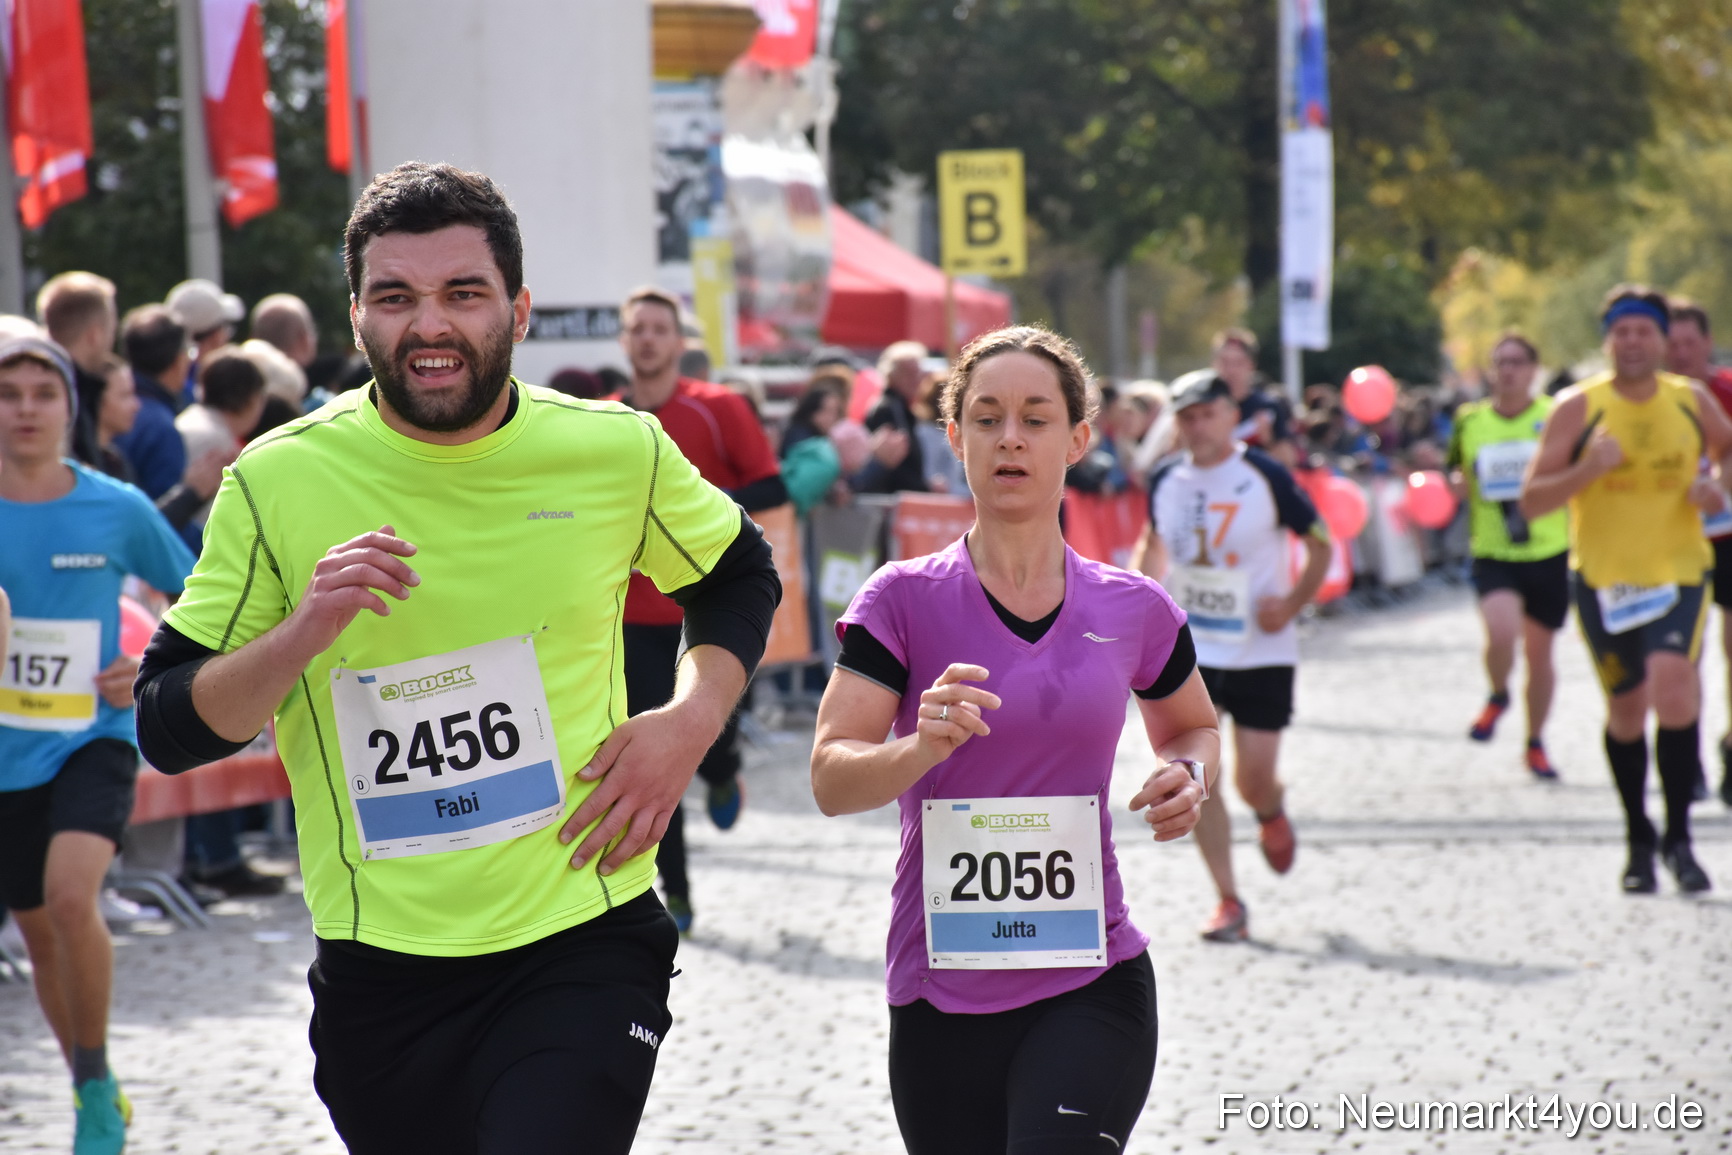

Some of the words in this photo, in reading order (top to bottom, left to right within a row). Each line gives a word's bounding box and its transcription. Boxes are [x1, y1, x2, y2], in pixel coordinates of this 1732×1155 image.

[964, 191, 1002, 247] B
[9, 653, 70, 687] 157
[400, 664, 475, 697] BOCK
[404, 694, 426, 703] inspired
[427, 691, 434, 699] by
[435, 687, 451, 696] smart
[452, 681, 477, 691] concepts
[368, 702, 520, 785] 2456
[356, 780, 364, 790] D
[434, 792, 480, 818] Fabi
[988, 812, 1050, 828] BOCK
[950, 850, 1075, 901] 2056
[992, 921, 1036, 938] Jutta
